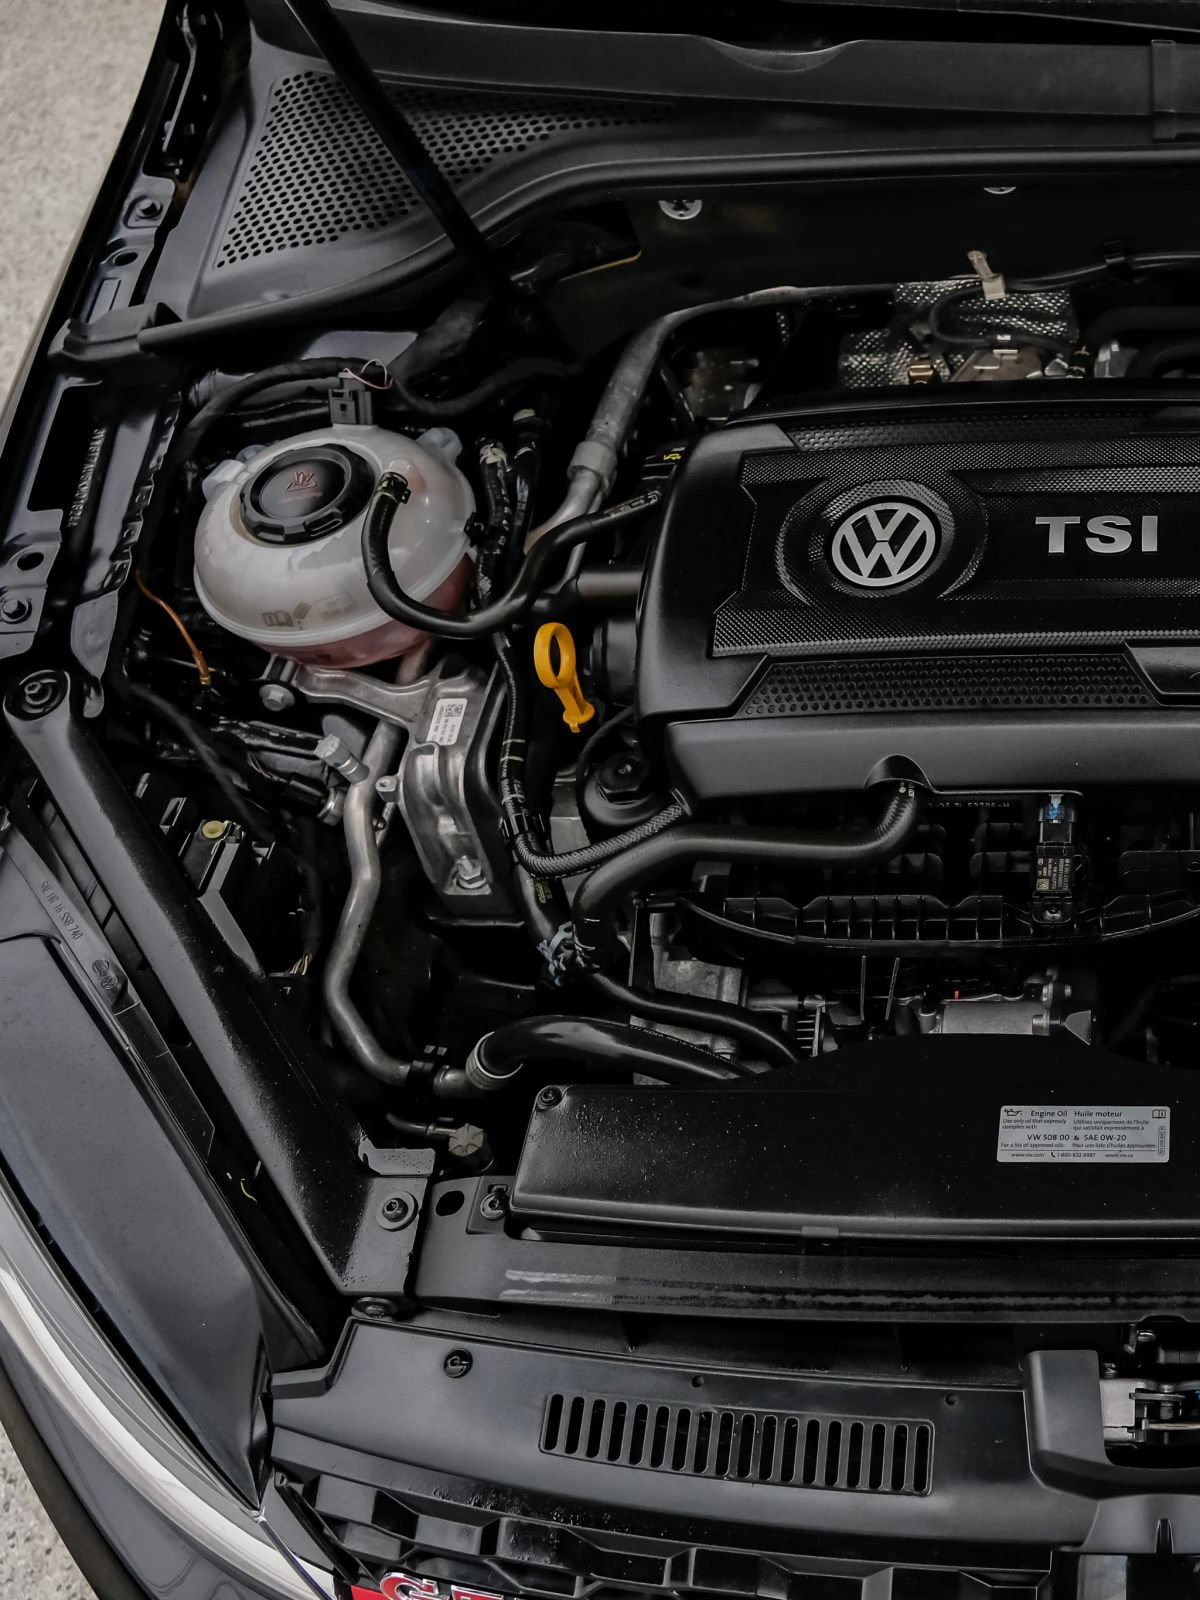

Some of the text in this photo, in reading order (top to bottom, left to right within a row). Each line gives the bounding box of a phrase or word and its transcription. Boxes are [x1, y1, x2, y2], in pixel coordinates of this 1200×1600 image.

[832, 502, 936, 587] VW
[1035, 515, 1158, 554] TSI
[54, 903, 66, 914] 16
[68, 924, 84, 940] 740
[1031, 1110, 1056, 1118] Engine
